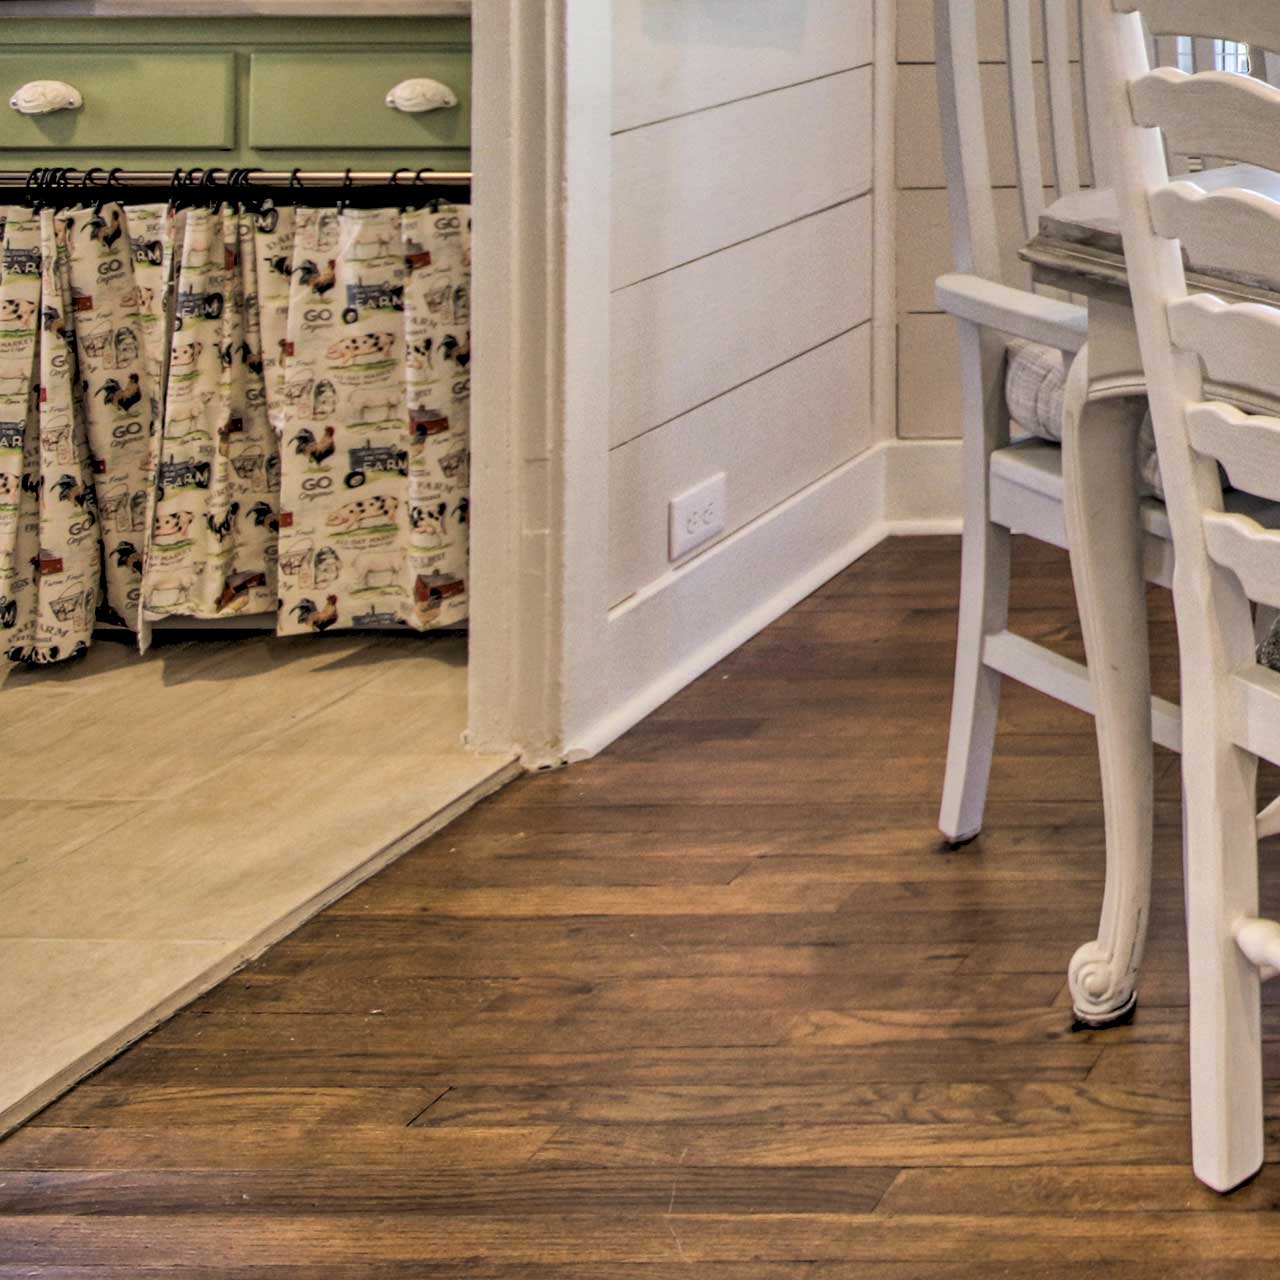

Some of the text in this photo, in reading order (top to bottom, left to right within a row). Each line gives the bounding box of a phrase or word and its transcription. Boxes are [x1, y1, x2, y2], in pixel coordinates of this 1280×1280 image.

[434, 217, 460, 230] GO
[98, 259, 122, 276] GO
[304, 309, 332, 322] GO
[113, 422, 142, 439] GO
[164, 471, 208, 487] FARM
[302, 476, 332, 491] GO
